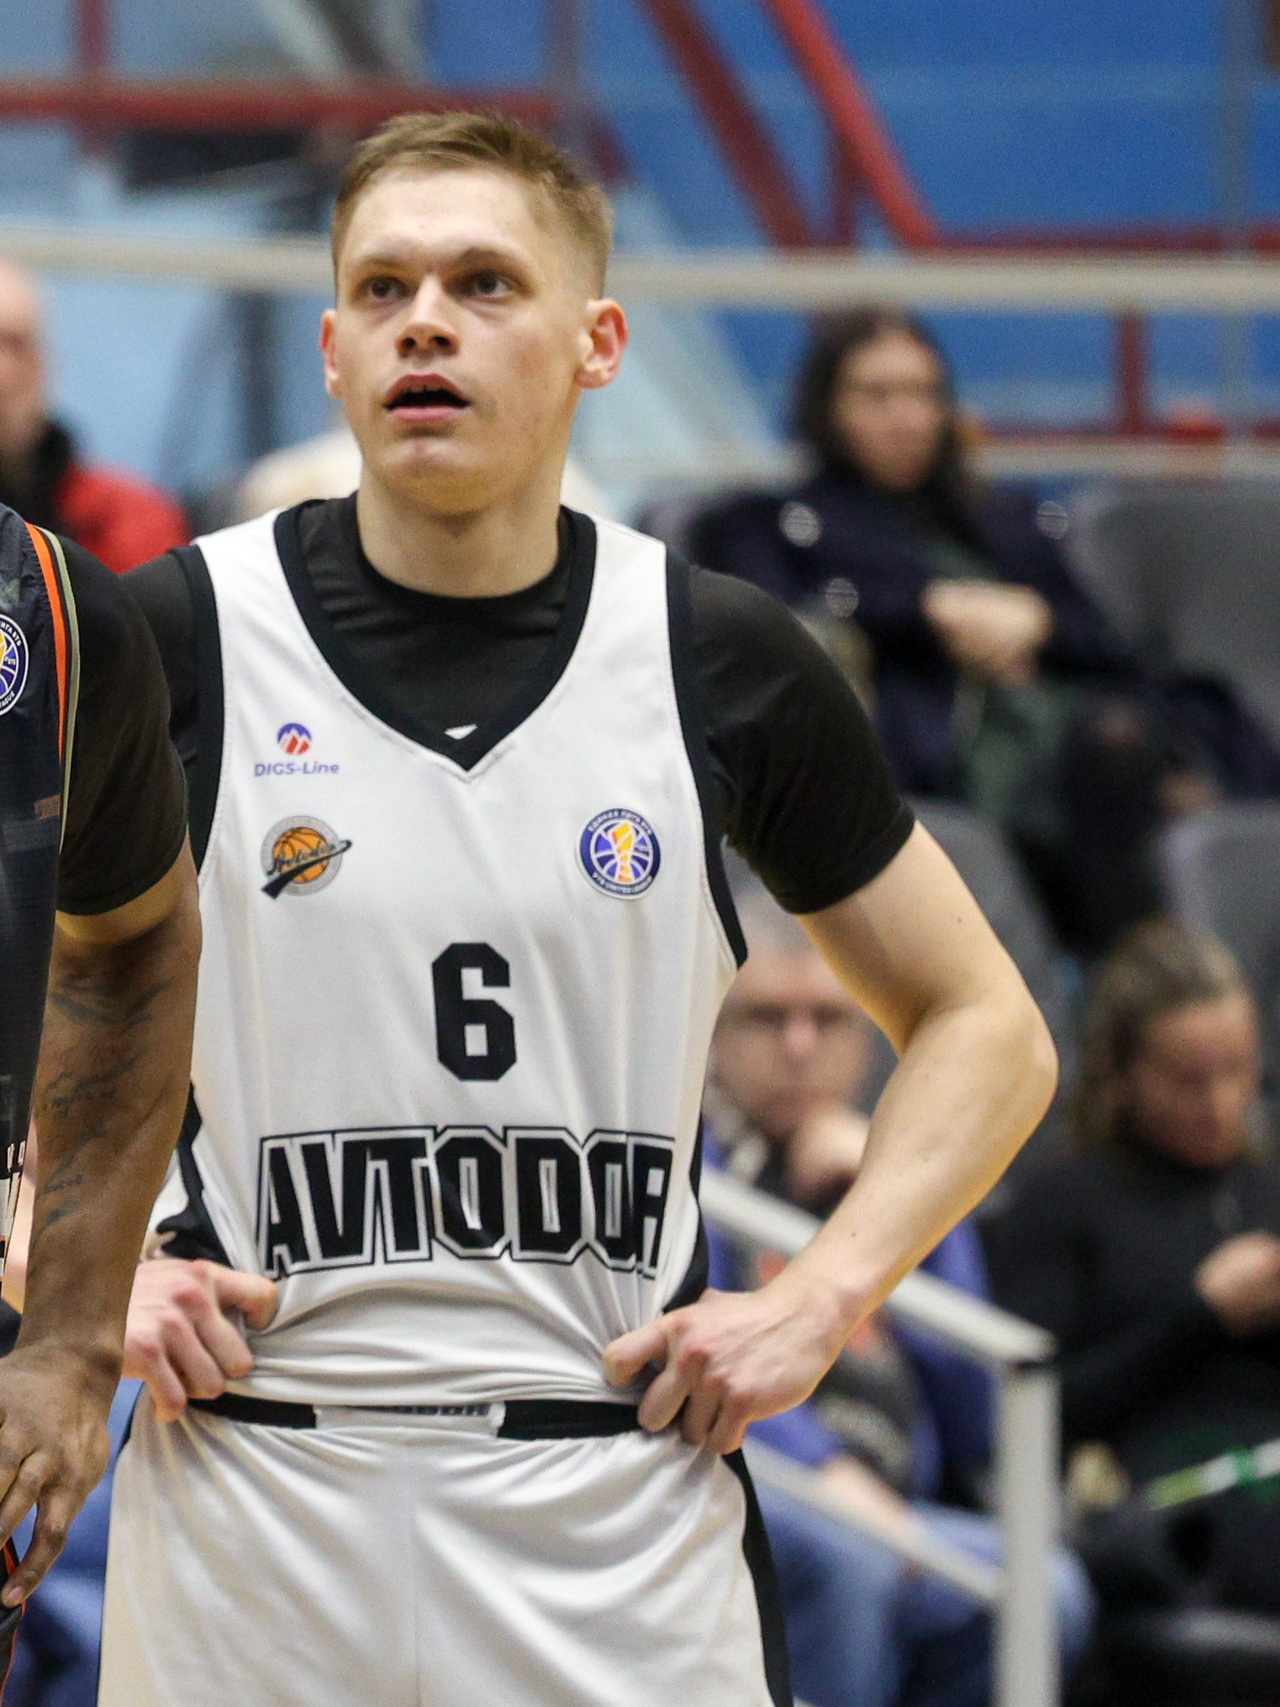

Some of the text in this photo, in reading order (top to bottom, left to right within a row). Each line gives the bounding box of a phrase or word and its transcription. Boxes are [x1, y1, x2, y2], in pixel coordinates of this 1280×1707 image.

[11, 630, 22, 647] ВТБ
[254, 761, 340, 777] DIGS-Line
[432, 943, 516, 1082] 6
[256, 1125, 676, 1280] AVTODOR
